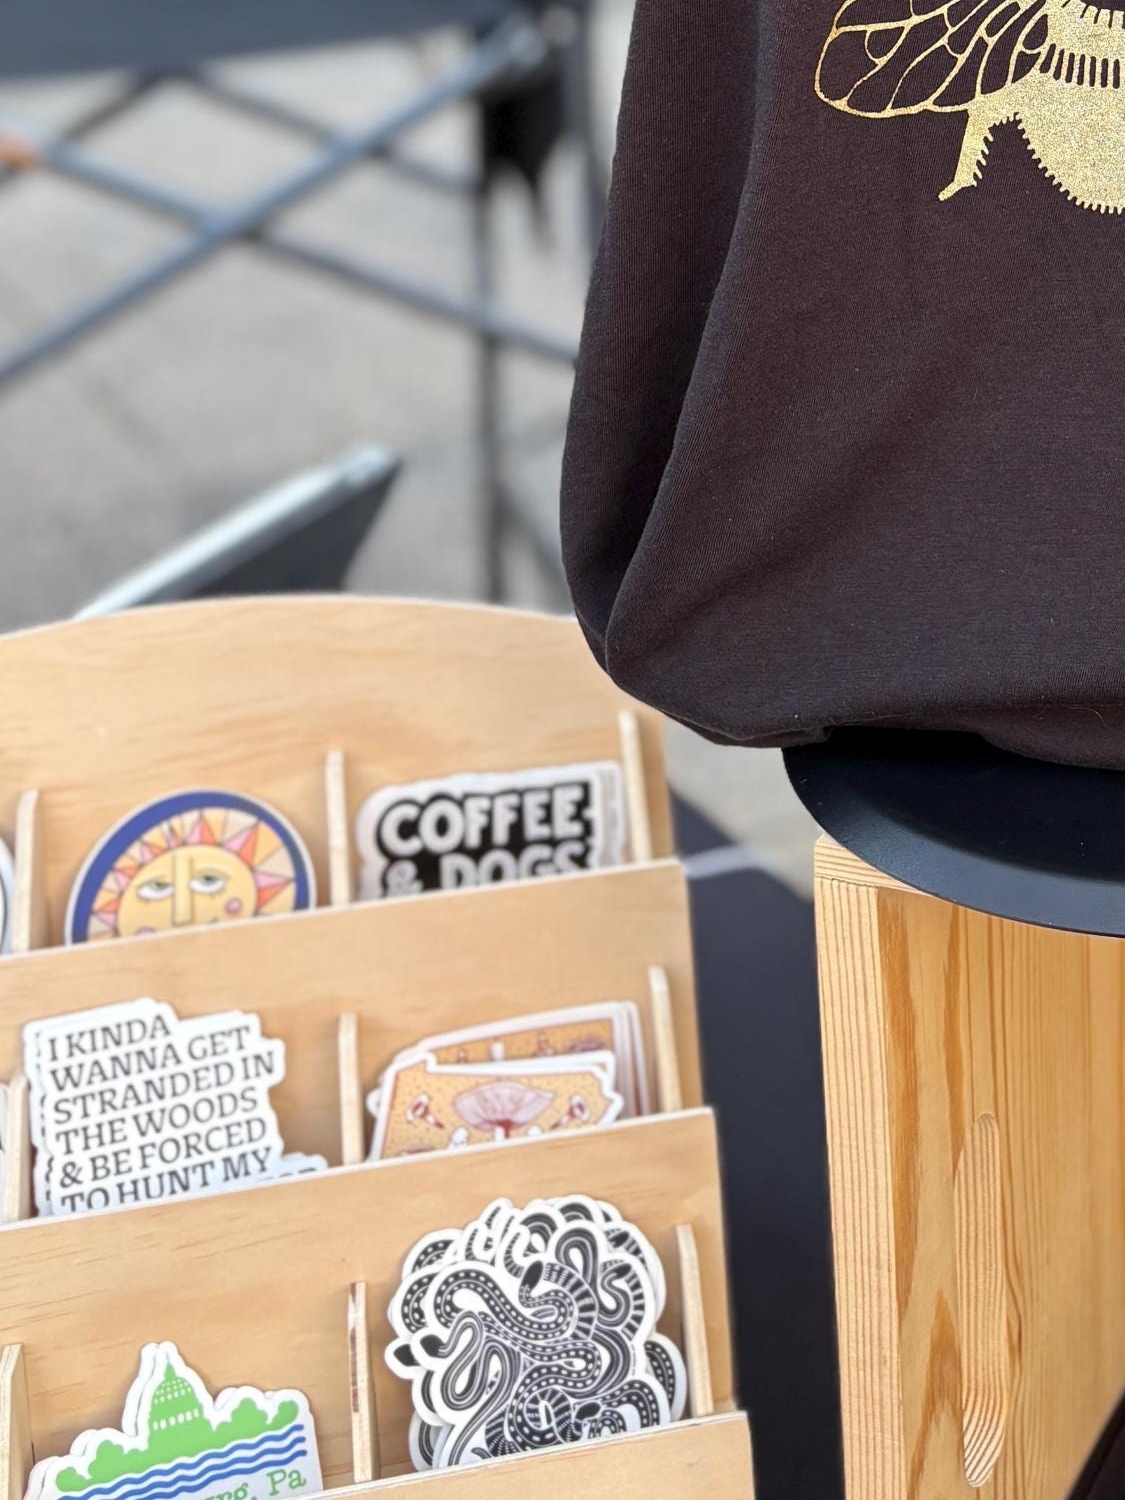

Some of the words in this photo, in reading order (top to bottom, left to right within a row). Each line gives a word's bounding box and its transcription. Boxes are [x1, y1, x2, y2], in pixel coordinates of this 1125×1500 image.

[380, 784, 584, 857] COFFEE
[49, 1038, 59, 1061] I
[66, 1014, 171, 1058] KINDA
[51, 1043, 182, 1092] WANNA
[187, 1025, 250, 1061] GET
[54, 1061, 235, 1125] STRANDED
[242, 1051, 275, 1081] IN
[55, 1118, 128, 1155] THE
[133, 1086, 258, 1137] WOODS
[59, 1161, 83, 1188] &
[90, 1148, 132, 1181] BE
[139, 1117, 266, 1169] FORCED
[61, 1187, 110, 1212] TO
[117, 1160, 215, 1204] HUNT
[223, 1147, 272, 1182] MY
[266, 1469, 307, 1496] Pa
